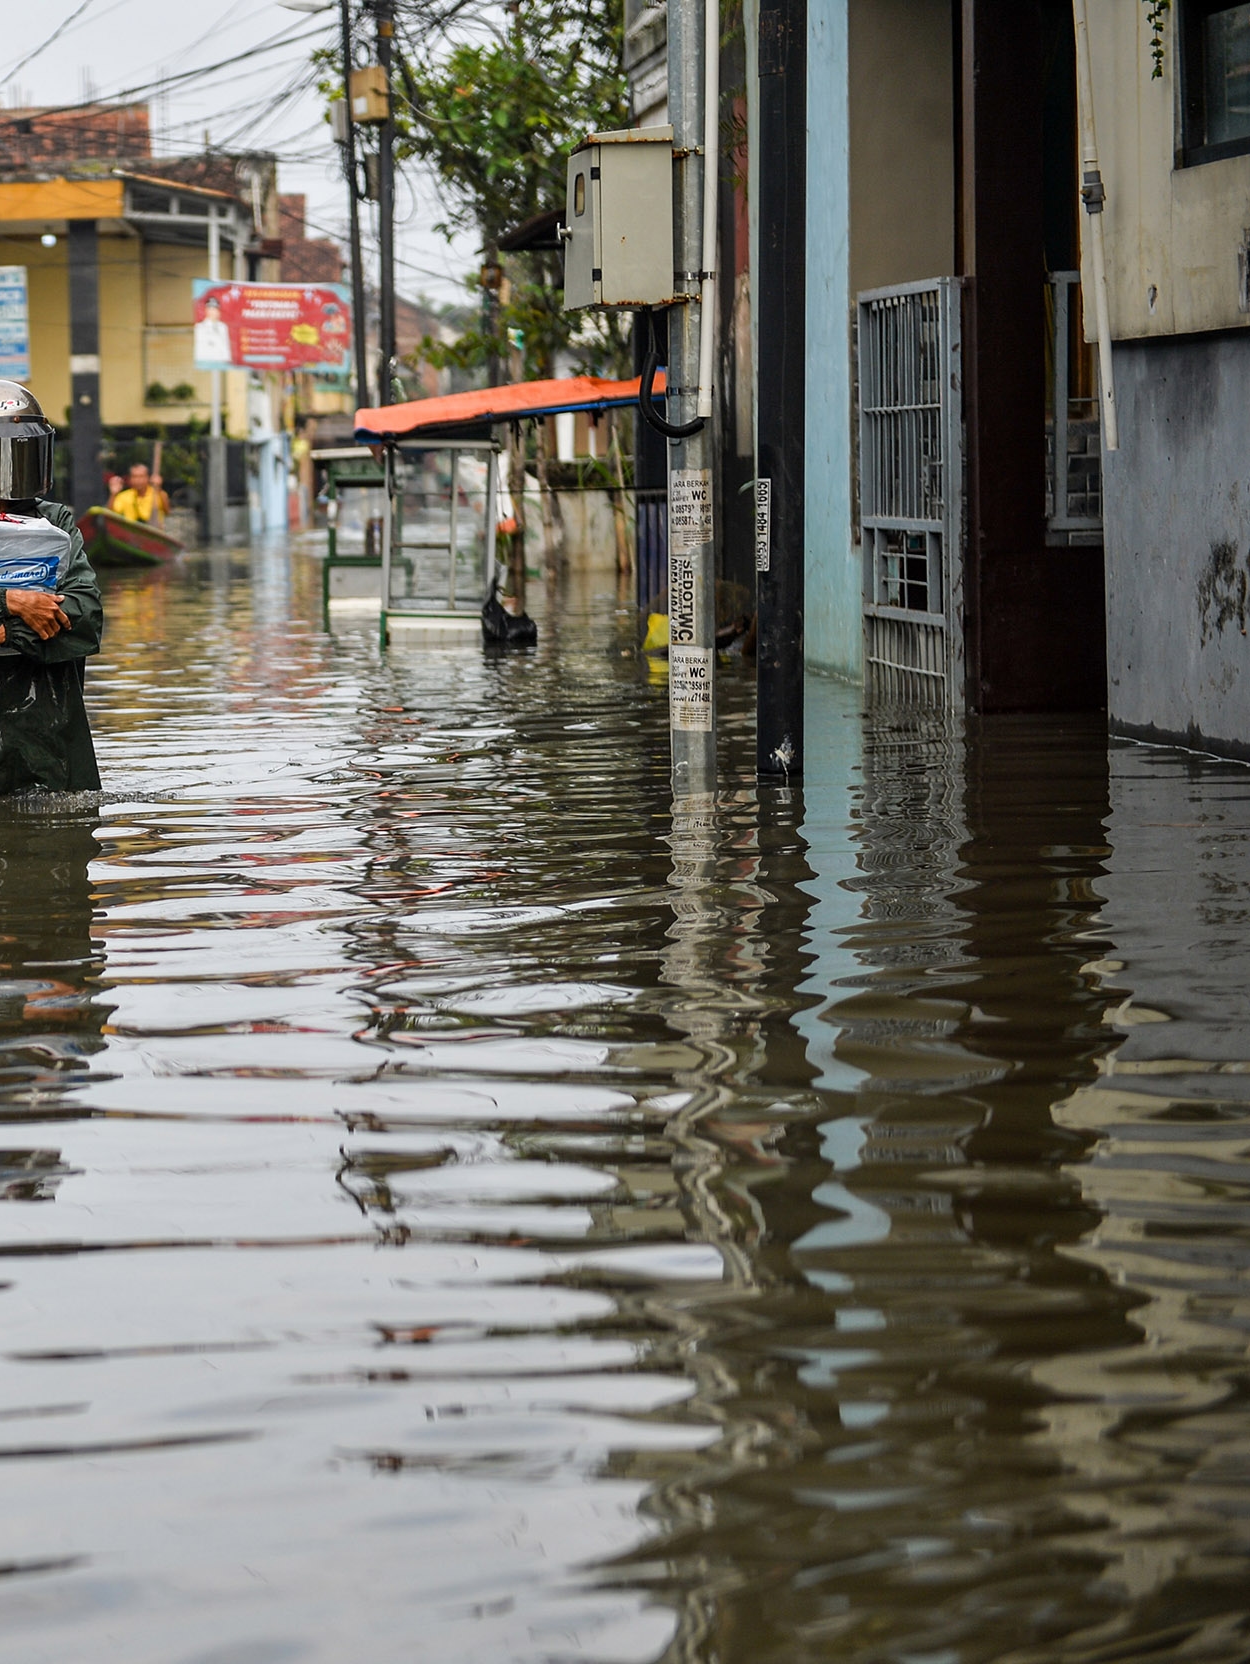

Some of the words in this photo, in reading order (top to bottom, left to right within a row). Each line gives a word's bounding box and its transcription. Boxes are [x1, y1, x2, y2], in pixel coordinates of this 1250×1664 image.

[691, 490, 707, 501] WC
[756, 482, 767, 509] 1665
[756, 512, 767, 537] 1484
[689, 667, 706, 678] WC
